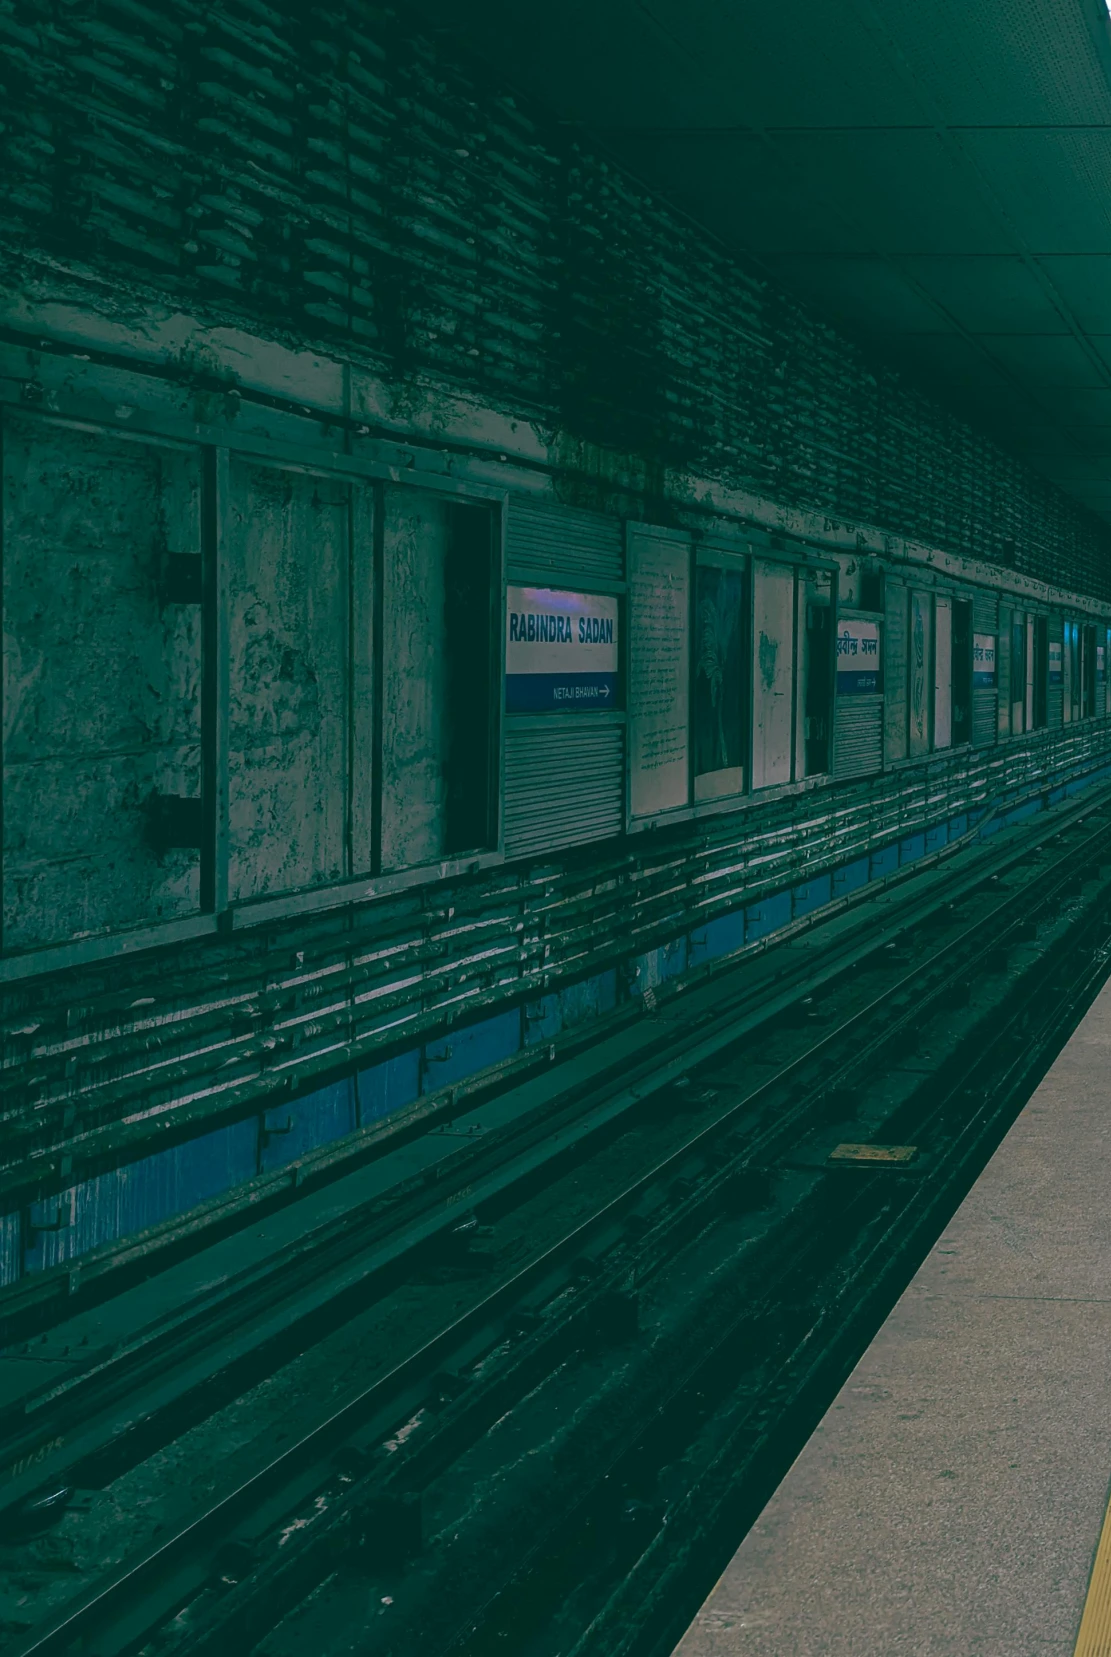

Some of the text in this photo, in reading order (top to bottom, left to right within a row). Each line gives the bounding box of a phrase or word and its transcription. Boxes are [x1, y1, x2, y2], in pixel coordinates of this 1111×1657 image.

[509, 612, 613, 644] RABINDRA SADAN
[837, 630, 877, 656] রবীন্দ্র সদন
[553, 686, 599, 700] NETAJI BHAVAN
